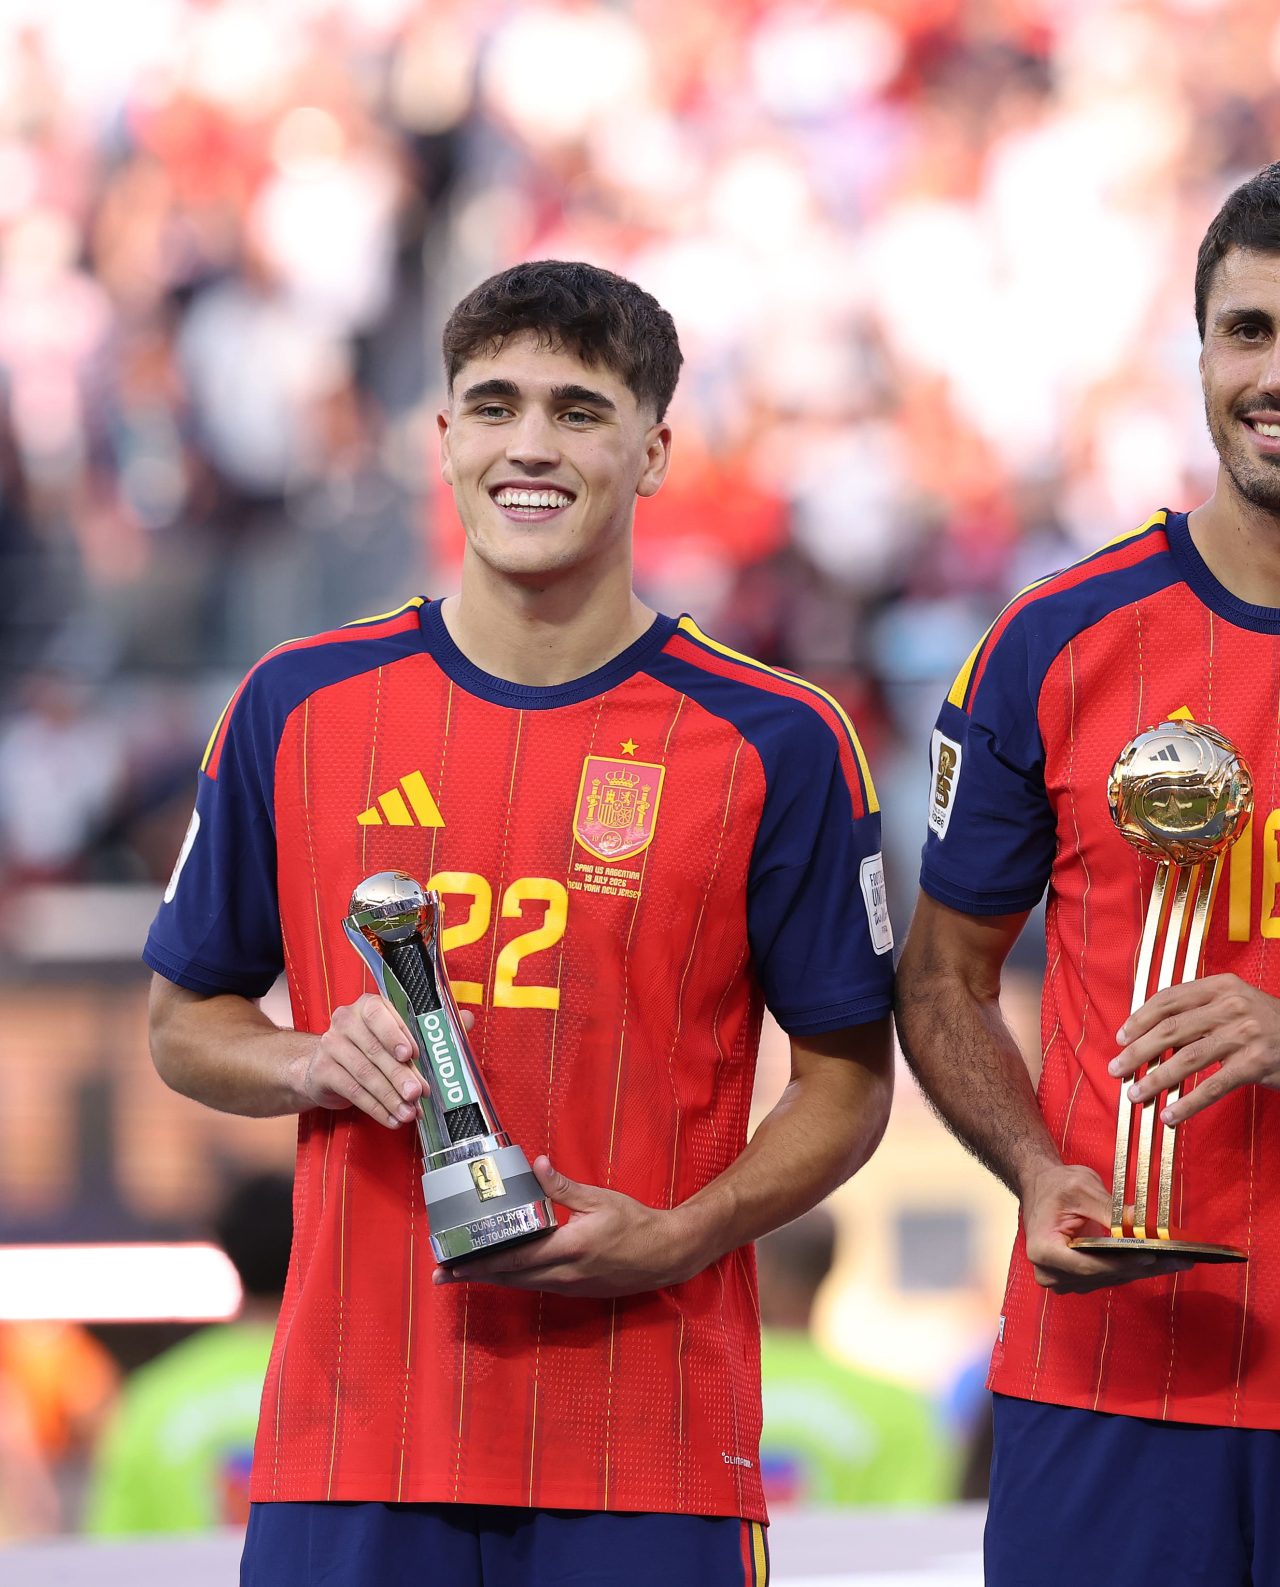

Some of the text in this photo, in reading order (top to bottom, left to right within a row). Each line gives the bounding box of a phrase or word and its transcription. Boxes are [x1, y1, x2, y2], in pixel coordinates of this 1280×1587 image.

[574, 863, 594, 873] SPAIN
[605, 868, 640, 880] ARGENTINA
[585, 874, 627, 887] 19 JULY 2026
[568, 881, 641, 898] NEW YORK NEW JERSEY
[426, 871, 569, 1011] 22
[424, 1014, 464, 1104] aramco
[465, 1218, 496, 1235] YOUNG
[497, 1209, 527, 1226] PLAYER
[469, 1219, 543, 1248] THE TOURNAMENT
